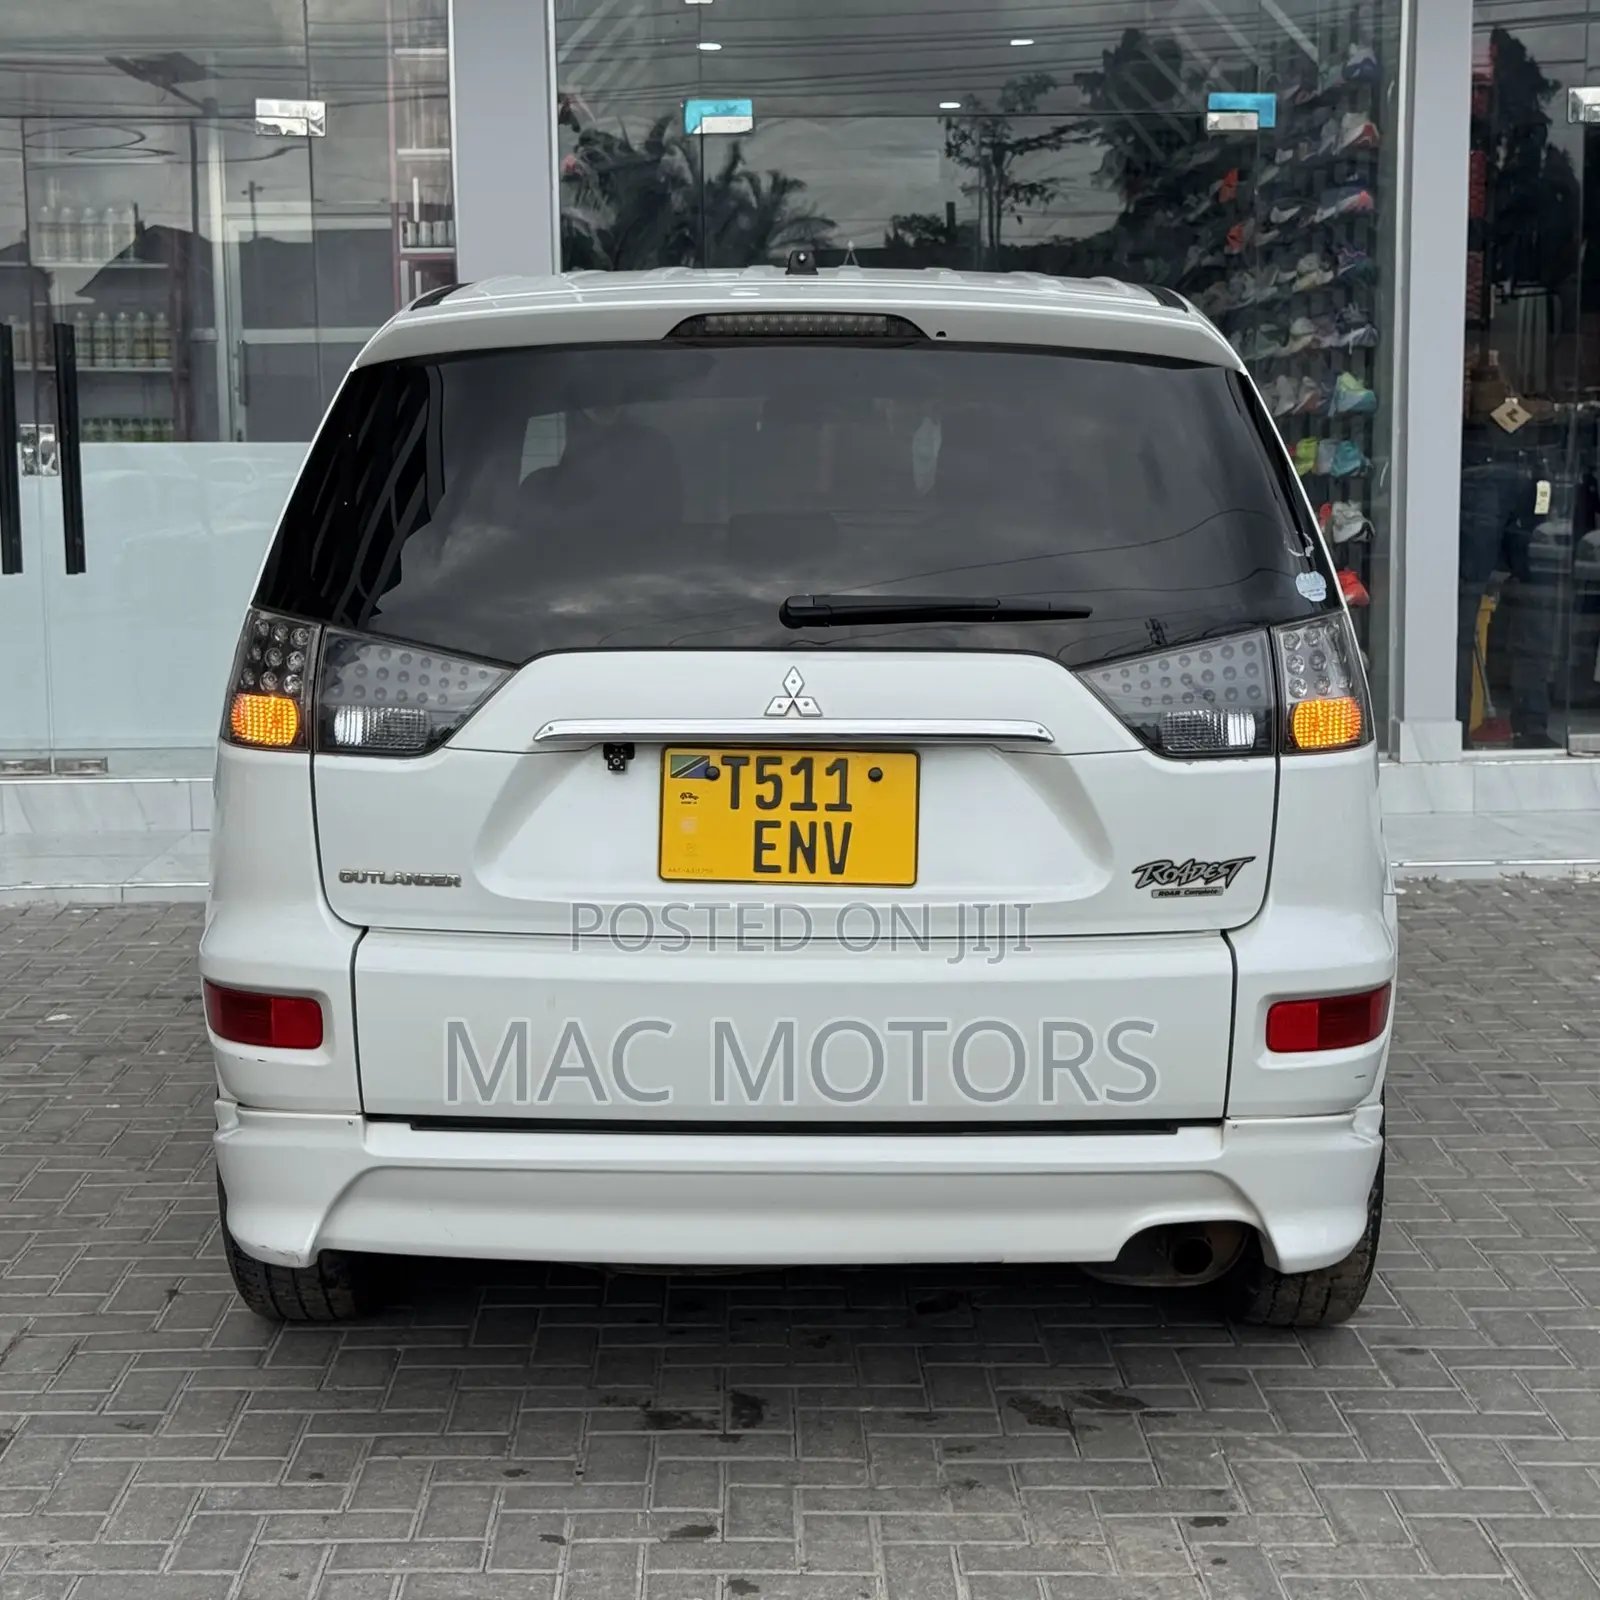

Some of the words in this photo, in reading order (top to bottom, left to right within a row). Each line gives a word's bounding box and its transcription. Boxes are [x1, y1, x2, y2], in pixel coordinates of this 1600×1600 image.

[721, 755, 853, 812] T511
[752, 819, 853, 875] ENV
[339, 869, 462, 887] OUTLANDER
